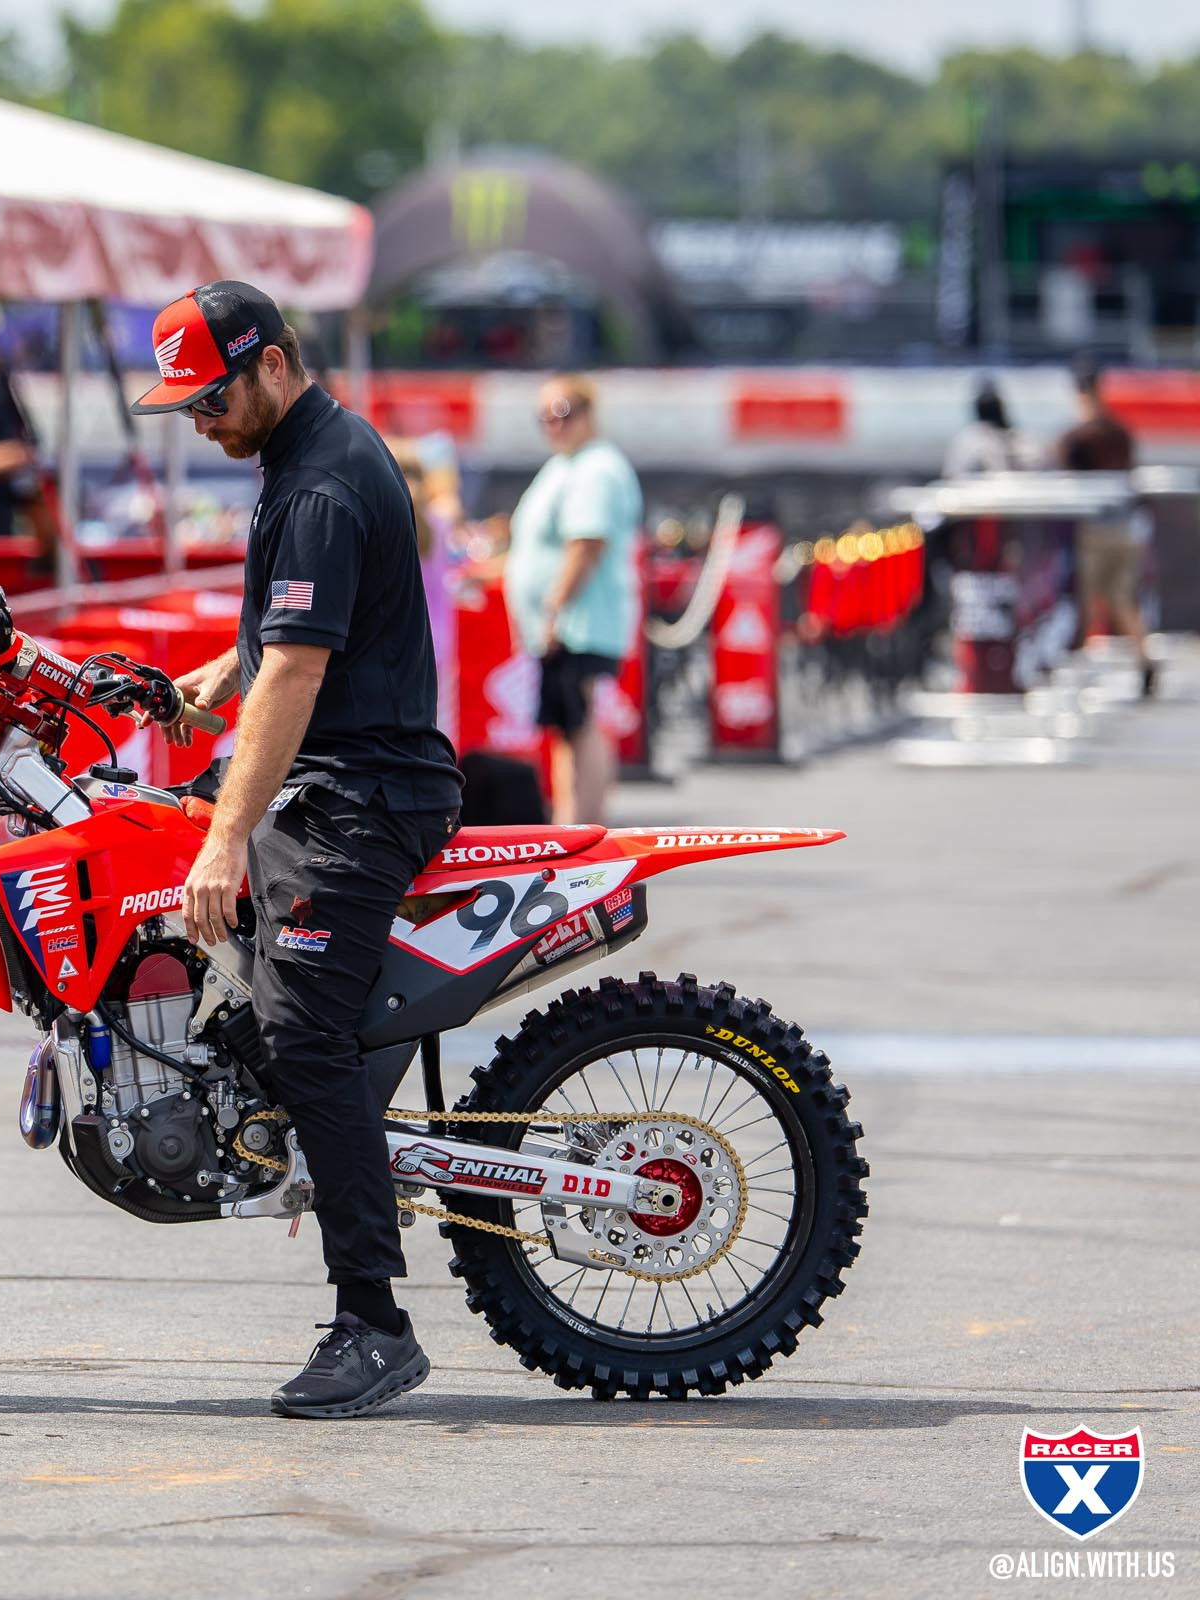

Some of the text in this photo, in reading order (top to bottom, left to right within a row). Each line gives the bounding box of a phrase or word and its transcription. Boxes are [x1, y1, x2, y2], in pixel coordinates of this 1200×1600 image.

[160, 367, 197, 378] ONDA
[36, 661, 88, 698] RENTHAL
[102, 783, 128, 797] VP
[654, 834, 781, 848] DUNLOP
[441, 840, 568, 864] HONDA
[568, 871, 607, 889] SMX
[456, 874, 569, 955] 96
[275, 925, 331, 947] HRC
[714, 1028, 800, 1093] DUNLOP
[456, 1176, 540, 1193] CHAINWHEELS
